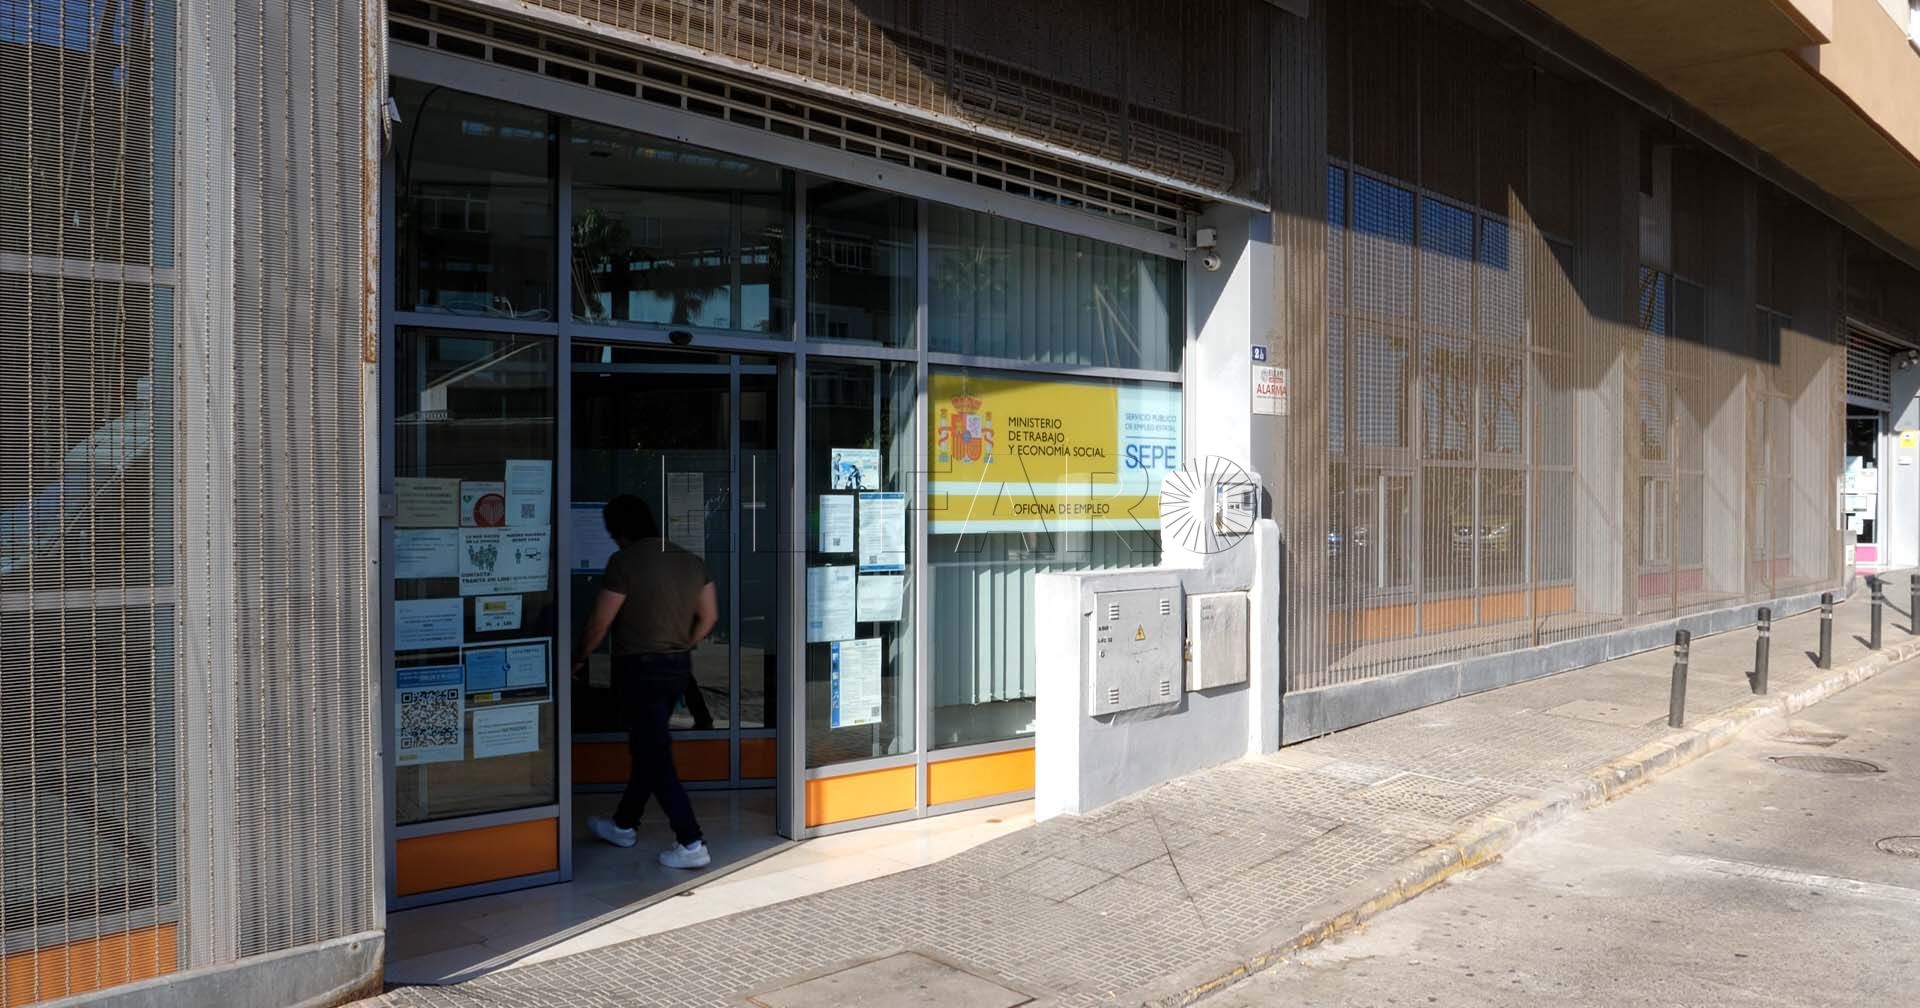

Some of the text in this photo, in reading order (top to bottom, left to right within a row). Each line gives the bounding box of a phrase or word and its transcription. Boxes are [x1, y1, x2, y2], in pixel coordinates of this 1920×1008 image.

[1256, 383, 1288, 397] ALARMA
[1008, 416, 1062, 430] MINISTERIO
[1008, 430, 1065, 444] DE TRABAJO
[1008, 444, 1106, 458] Y ECONOMÍA SOCIAL
[1125, 444, 1177, 470] SEPE
[1013, 503, 1110, 515] OFICINA DE EMPLEO
